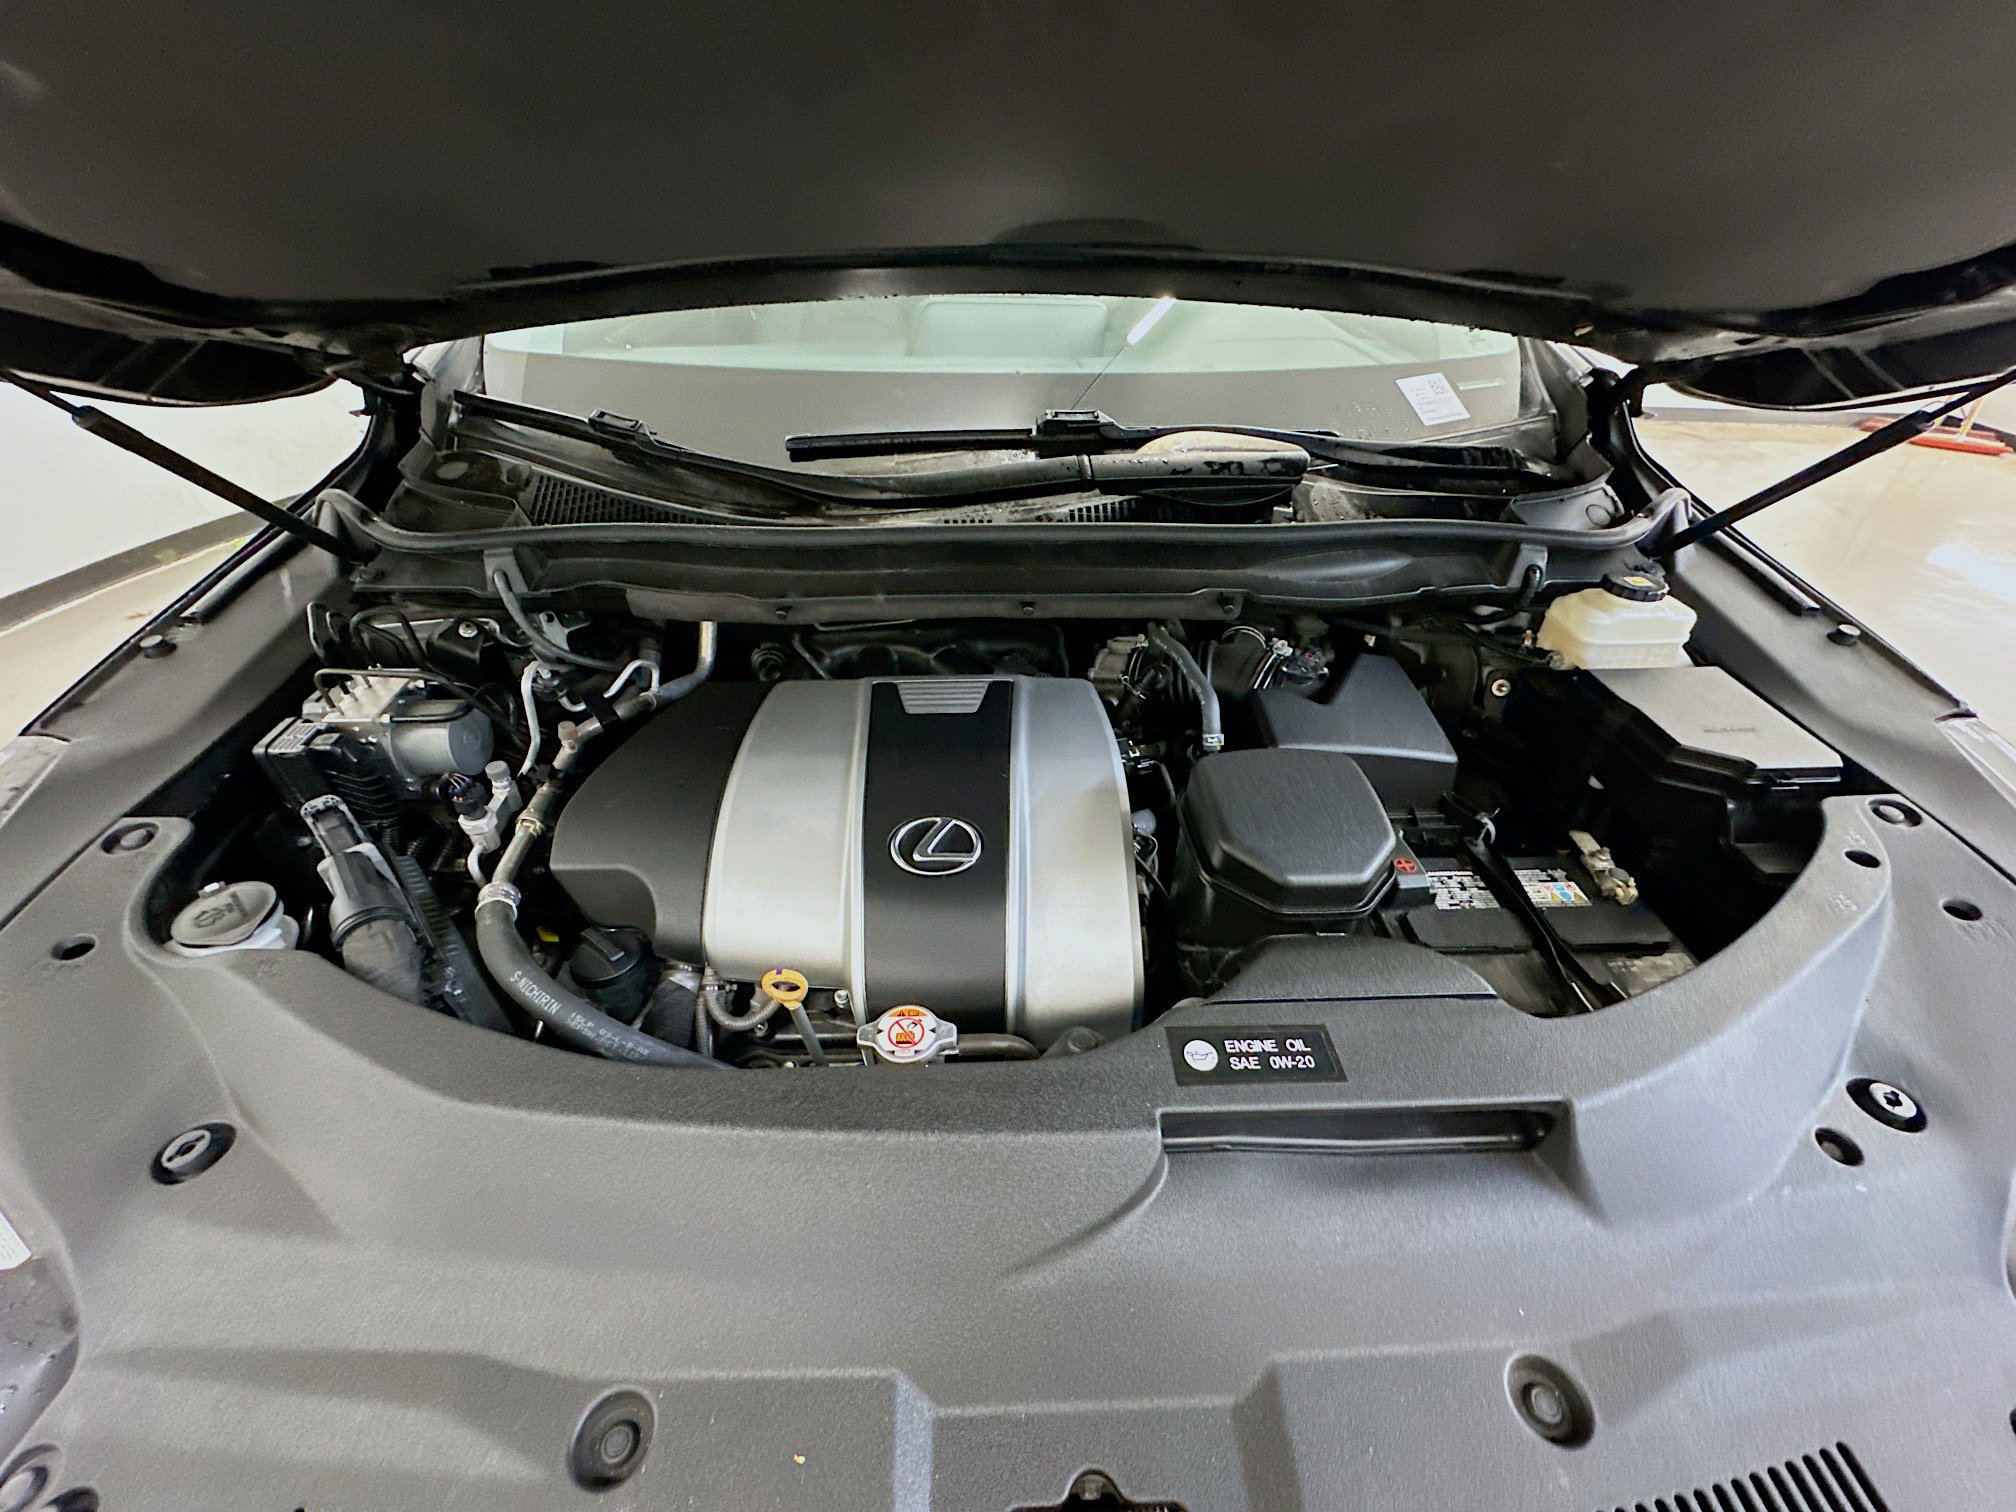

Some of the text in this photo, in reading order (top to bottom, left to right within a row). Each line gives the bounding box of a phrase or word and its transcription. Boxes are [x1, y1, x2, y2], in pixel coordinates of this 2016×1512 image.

[510, 970, 563, 1016] S-NICHIRIN
[1224, 1039, 1311, 1053] ENGINE OIL
[1229, 1055, 1315, 1070] SAE 0W-20
